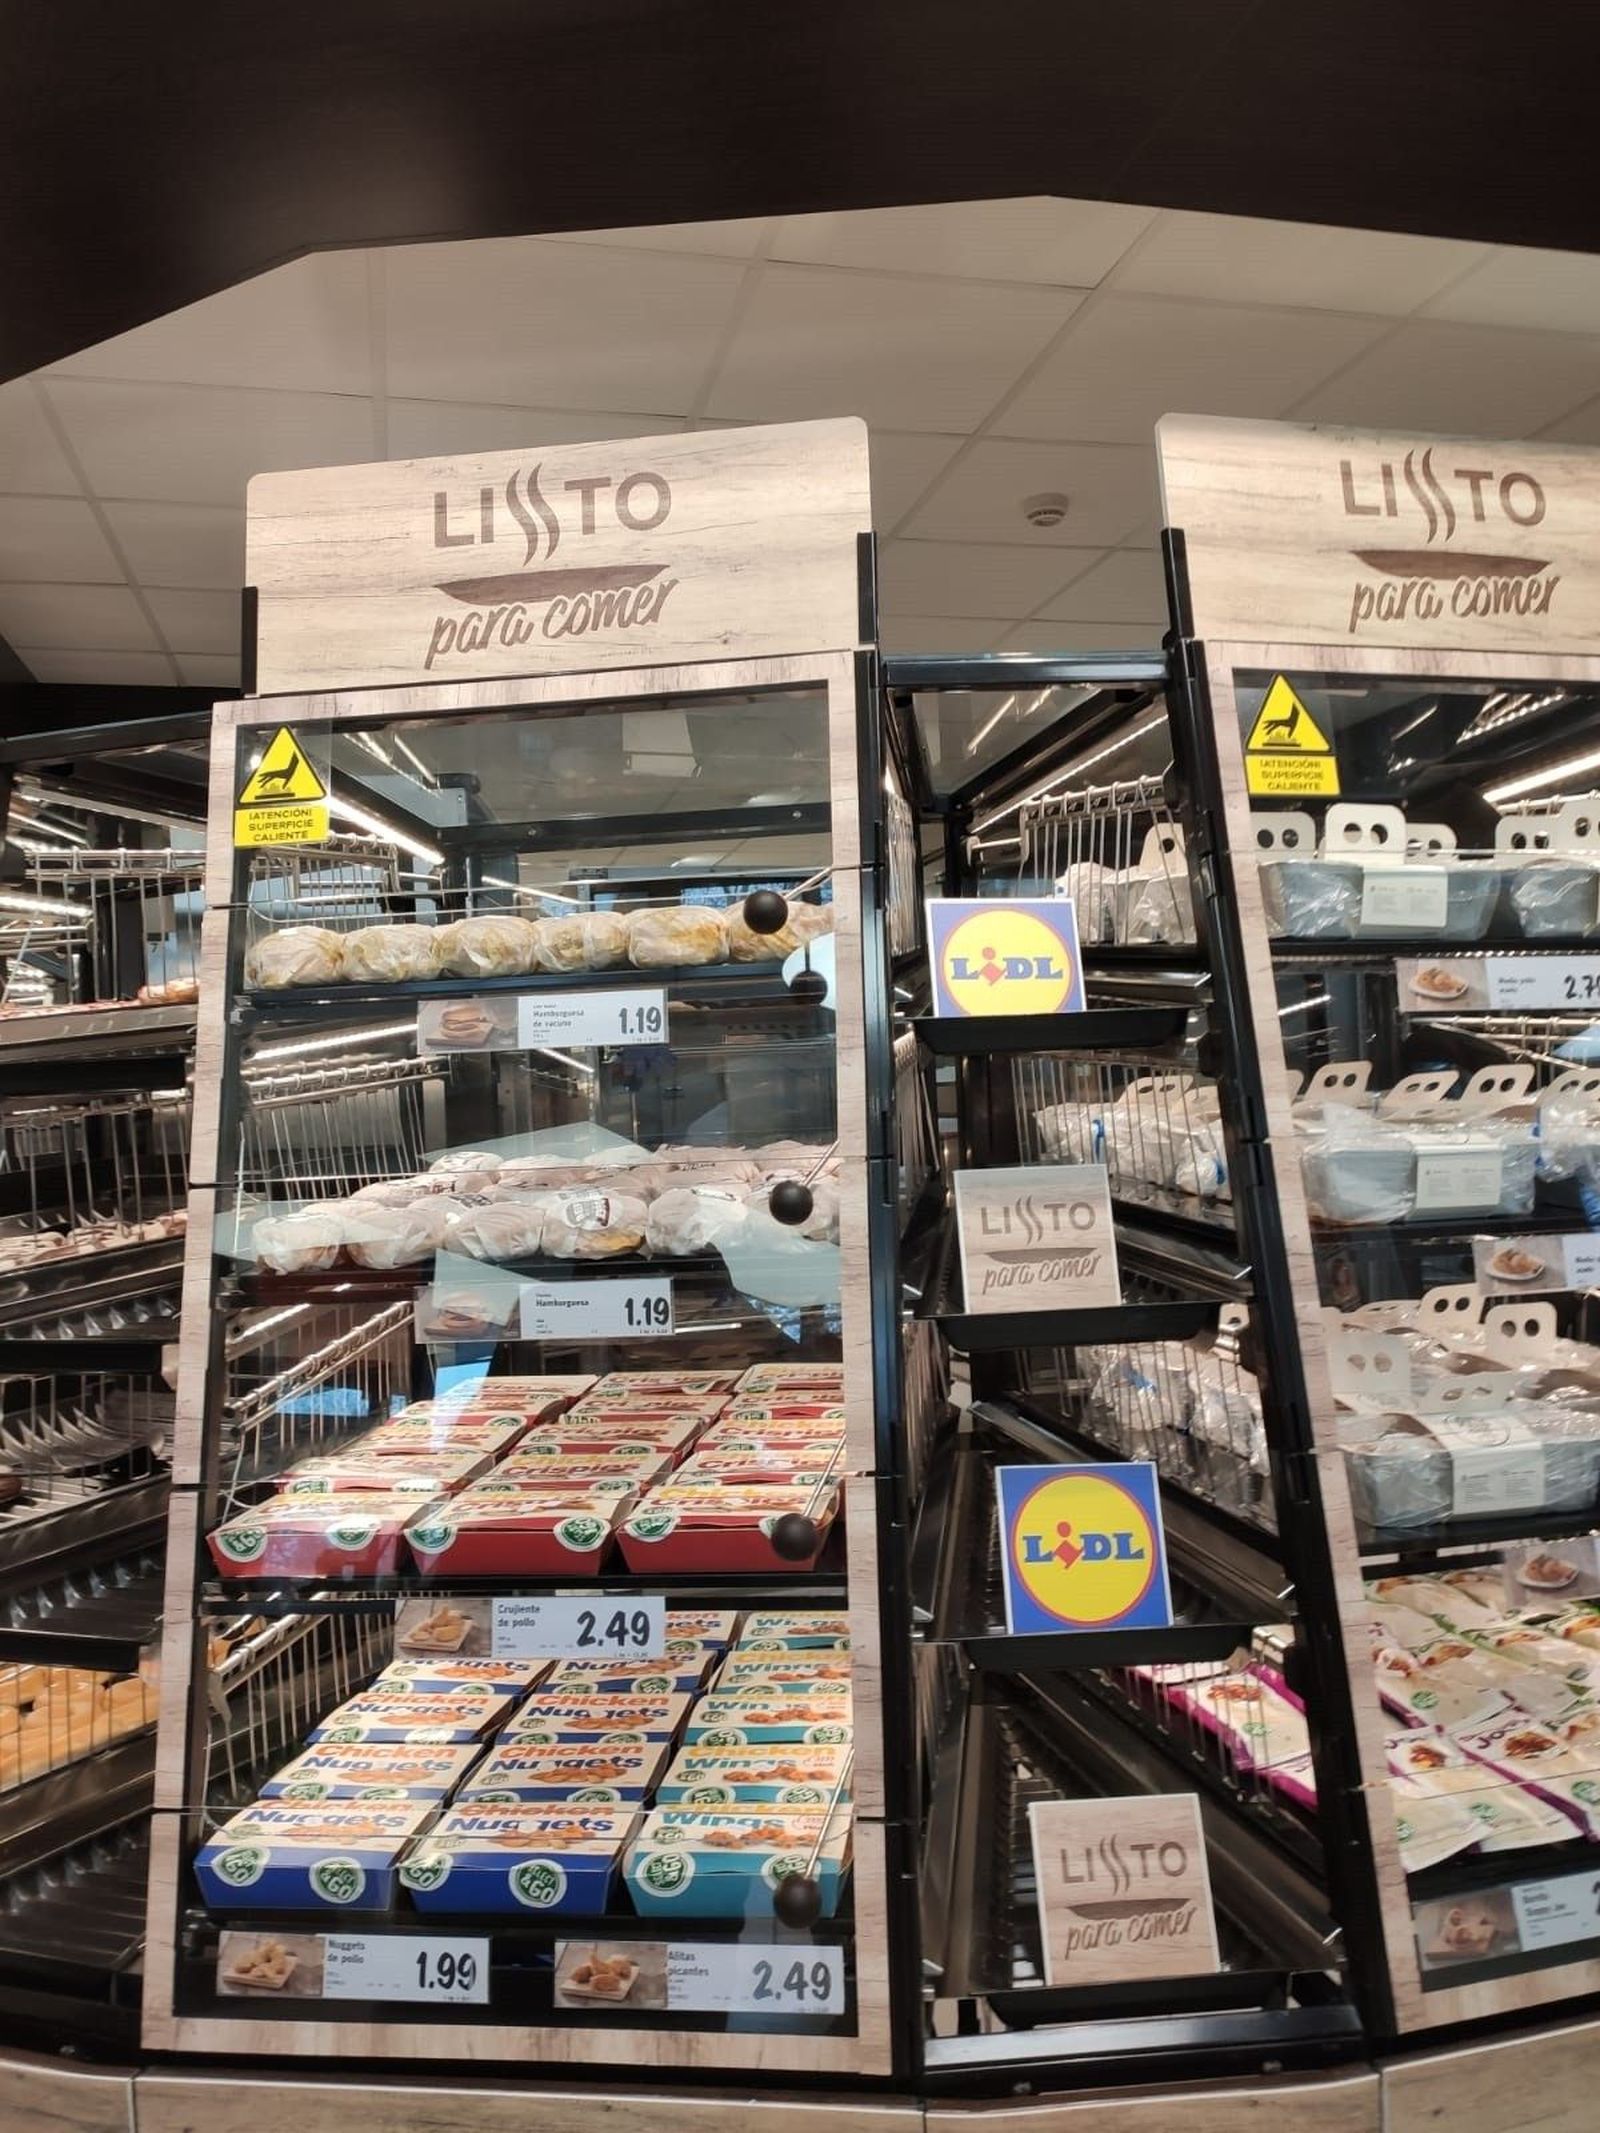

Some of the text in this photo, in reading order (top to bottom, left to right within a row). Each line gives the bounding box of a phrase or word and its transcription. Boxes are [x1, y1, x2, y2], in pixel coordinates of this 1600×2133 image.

[1350, 575, 1562, 633] para comer
[425, 579, 679, 669] para comer
[248, 819, 314, 831] SUPERFICIE
[253, 830, 308, 842] CALIENTE
[619, 1006, 661, 1035] 1.19
[982, 1254, 1101, 1295] para comer
[536, 1298, 589, 1308] Hamburguesa
[624, 1297, 669, 1326] 1.19
[498, 1604, 540, 1615] Crujiente
[498, 1617, 535, 1629] de pollo
[576, 1610, 650, 1647] 2.49
[536, 1695, 669, 1706] Chicken
[314, 1745, 457, 1759] Chicken
[499, 1745, 643, 1759] Chicken
[1065, 1907, 1197, 1960] para comer
[328, 1940, 365, 1952] Nuggets
[327, 1953, 364, 1965] de pollo
[416, 1951, 477, 1991] 1.99
[753, 1960, 832, 2001] 2.49
